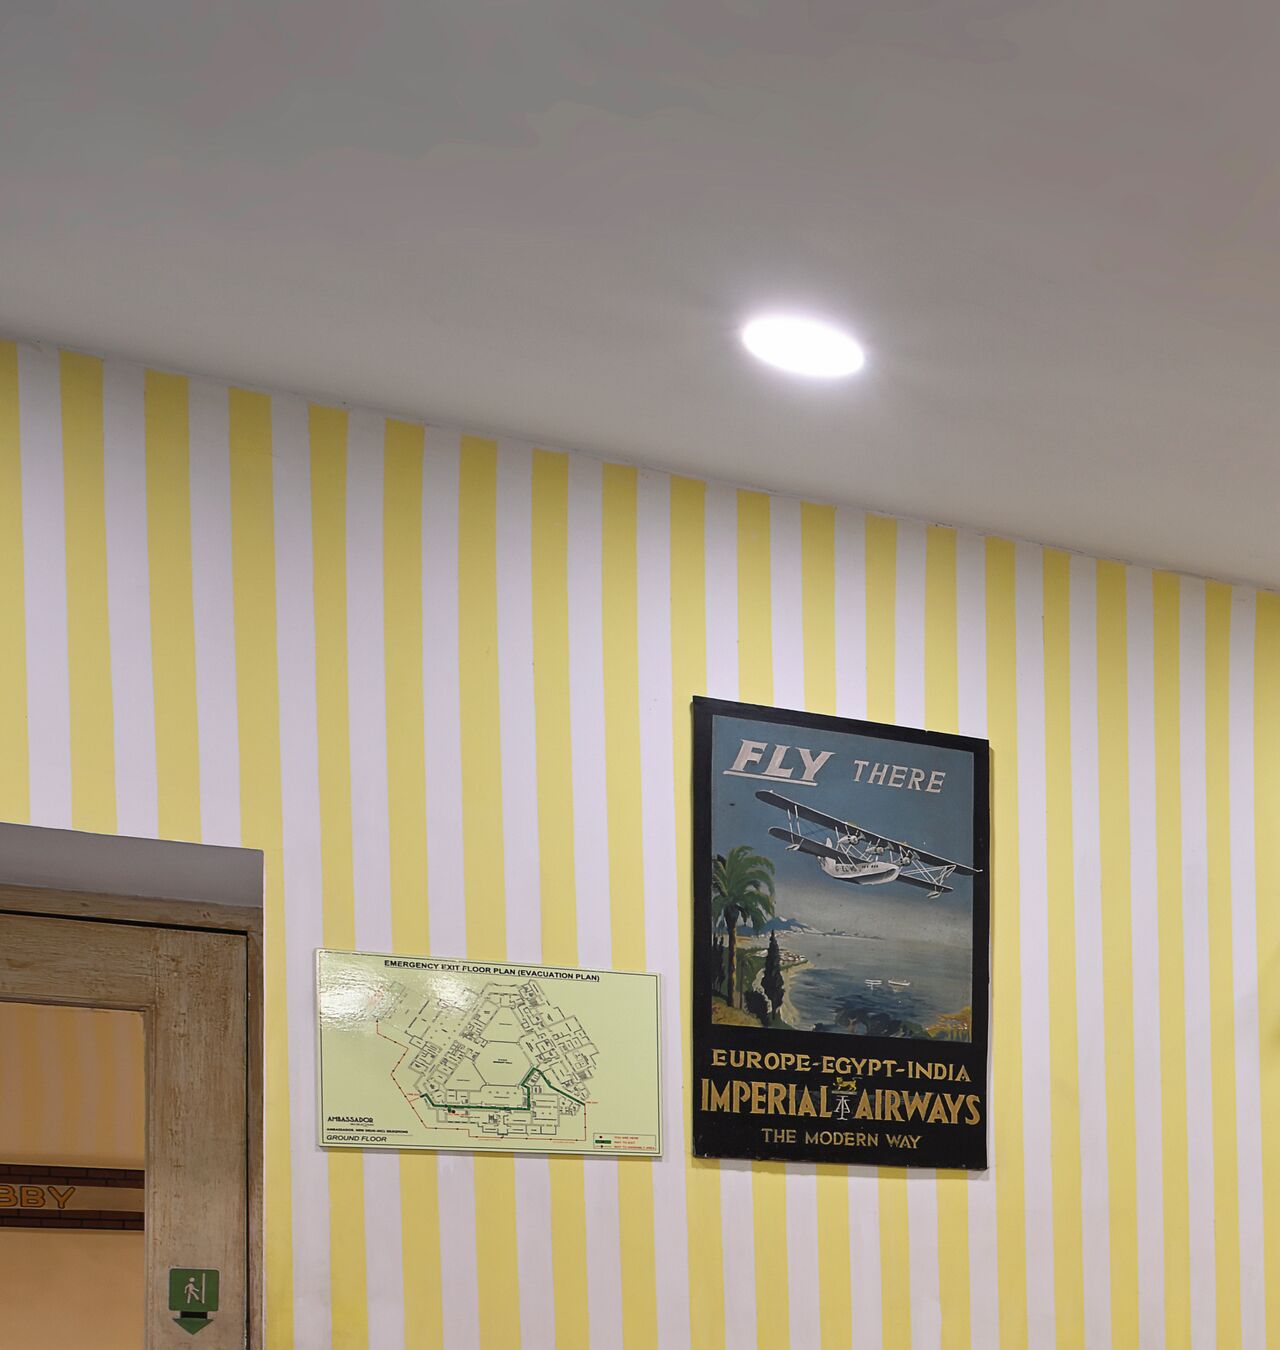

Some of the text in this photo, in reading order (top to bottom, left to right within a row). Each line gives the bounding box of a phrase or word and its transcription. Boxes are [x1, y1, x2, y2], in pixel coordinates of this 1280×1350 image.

[730, 738, 947, 794] FLY THERE
[384, 959, 439, 970] EMERGENCY
[461, 965, 491, 974] FLOOR
[493, 967, 516, 975] PLAN
[517, 968, 574, 980] (EVACUATION
[575, 974, 600, 982] PLAN)
[700, 1077, 982, 1126] IMPERIAL AIRWAYS
[327, 1134, 388, 1143] GROUND FLOOR
[761, 1127, 923, 1150] THE MODERN WAY
